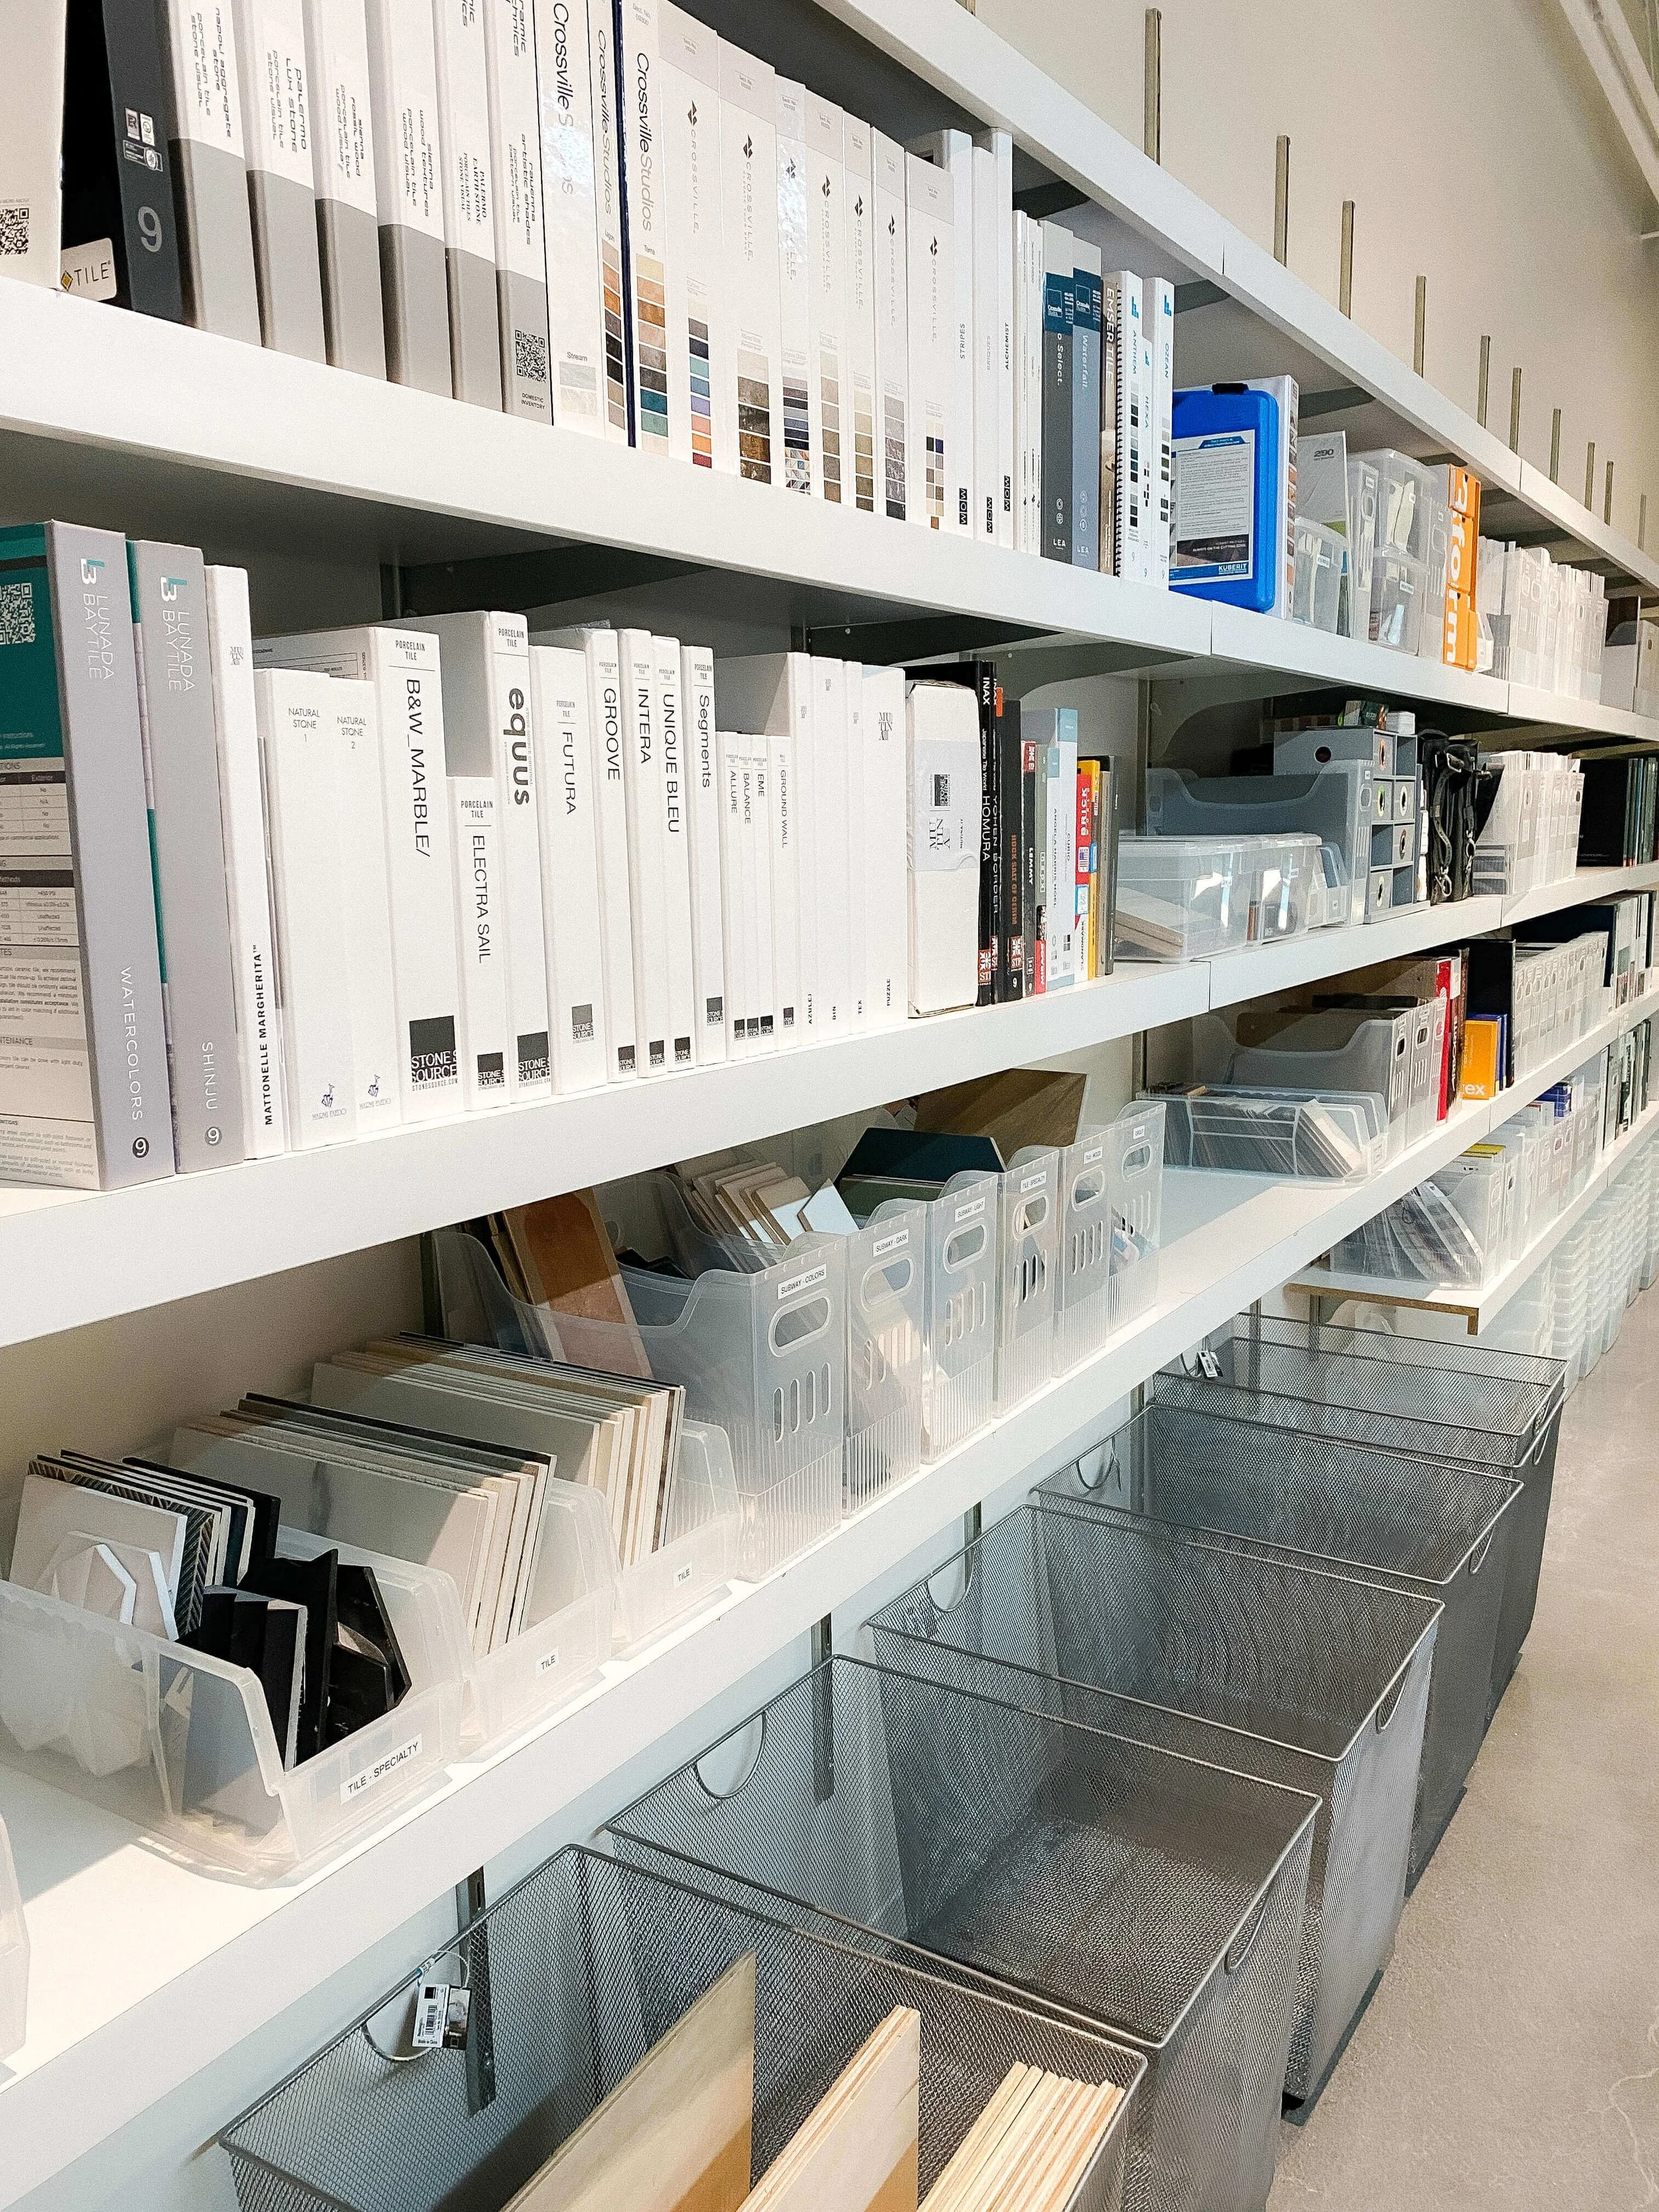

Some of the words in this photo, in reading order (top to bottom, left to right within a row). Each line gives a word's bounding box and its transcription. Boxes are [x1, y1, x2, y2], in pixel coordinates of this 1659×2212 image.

[138, 206, 162, 252] 9
[1106, 287, 1115, 343] EMSER
[567, 352, 588, 362] Stream
[521, 400, 545, 410] INVENTORY
[522, 393, 544, 404] DOMESTIC
[1053, 538, 1066, 547] LEA
[1144, 568, 1147, 577] 9
[1161, 570, 1165, 579] 9
[83, 593, 101, 679] BAYTILE
[96, 595, 114, 680] LUNADA
[498, 628, 524, 638] PORCELAIN
[162, 609, 181, 692] BAYTILE
[177, 611, 195, 692] LUNADA
[396, 640, 425, 652] PORCELAIN
[506, 638, 518, 648] TILE
[405, 652, 417, 660] TILE
[288, 707, 321, 718] NATURAL
[337, 717, 366, 726] NATURAL
[293, 719, 317, 729] STONE
[341, 727, 364, 737] STONE
[638, 688, 652, 764] INTERA
[604, 688, 620, 780] GROOVE
[664, 694, 677, 774] UNIQUE
[698, 695, 711, 788] Segments
[504, 688, 530, 805] equus
[406, 679, 430, 857] B&W_MARBLE/
[563, 732, 576, 815] FUTURA
[667, 780, 680, 832] BLEU
[1080, 787, 1090, 836] BRICK
[982, 796, 991, 861] HOMURA
[472, 836, 488, 919] ELECTRA
[478, 924, 491, 964] SAIL
[1011, 957, 1022, 967] STP
[1013, 977, 1017, 988] 9
[1029, 982, 1033, 992] 9
[121, 966, 143, 1120] WATERCOLORS
[411, 1051, 451, 1069] STONE
[518, 1057, 546, 1071] STONE
[202, 1041, 218, 1110] SHINJU
[478, 1070, 501, 1079] STONE
[259, 1044, 273, 1126] MATTONELLE
[207, 1128, 219, 1144] 9
[135, 1138, 147, 1156] 9
[957, 1208, 973, 1218] SUBWAY
[876, 1239, 893, 1253] SUBWAY
[896, 1234, 908, 1246] DARK
[780, 1279, 802, 1294] SUBWAY
[805, 1270, 825, 1284] COLORS
[677, 1568, 691, 1582] TILE
[540, 1654, 556, 1671] TILE
[348, 1776, 368, 1795] TILE
[374, 1742, 419, 1779] SPECIALTY
